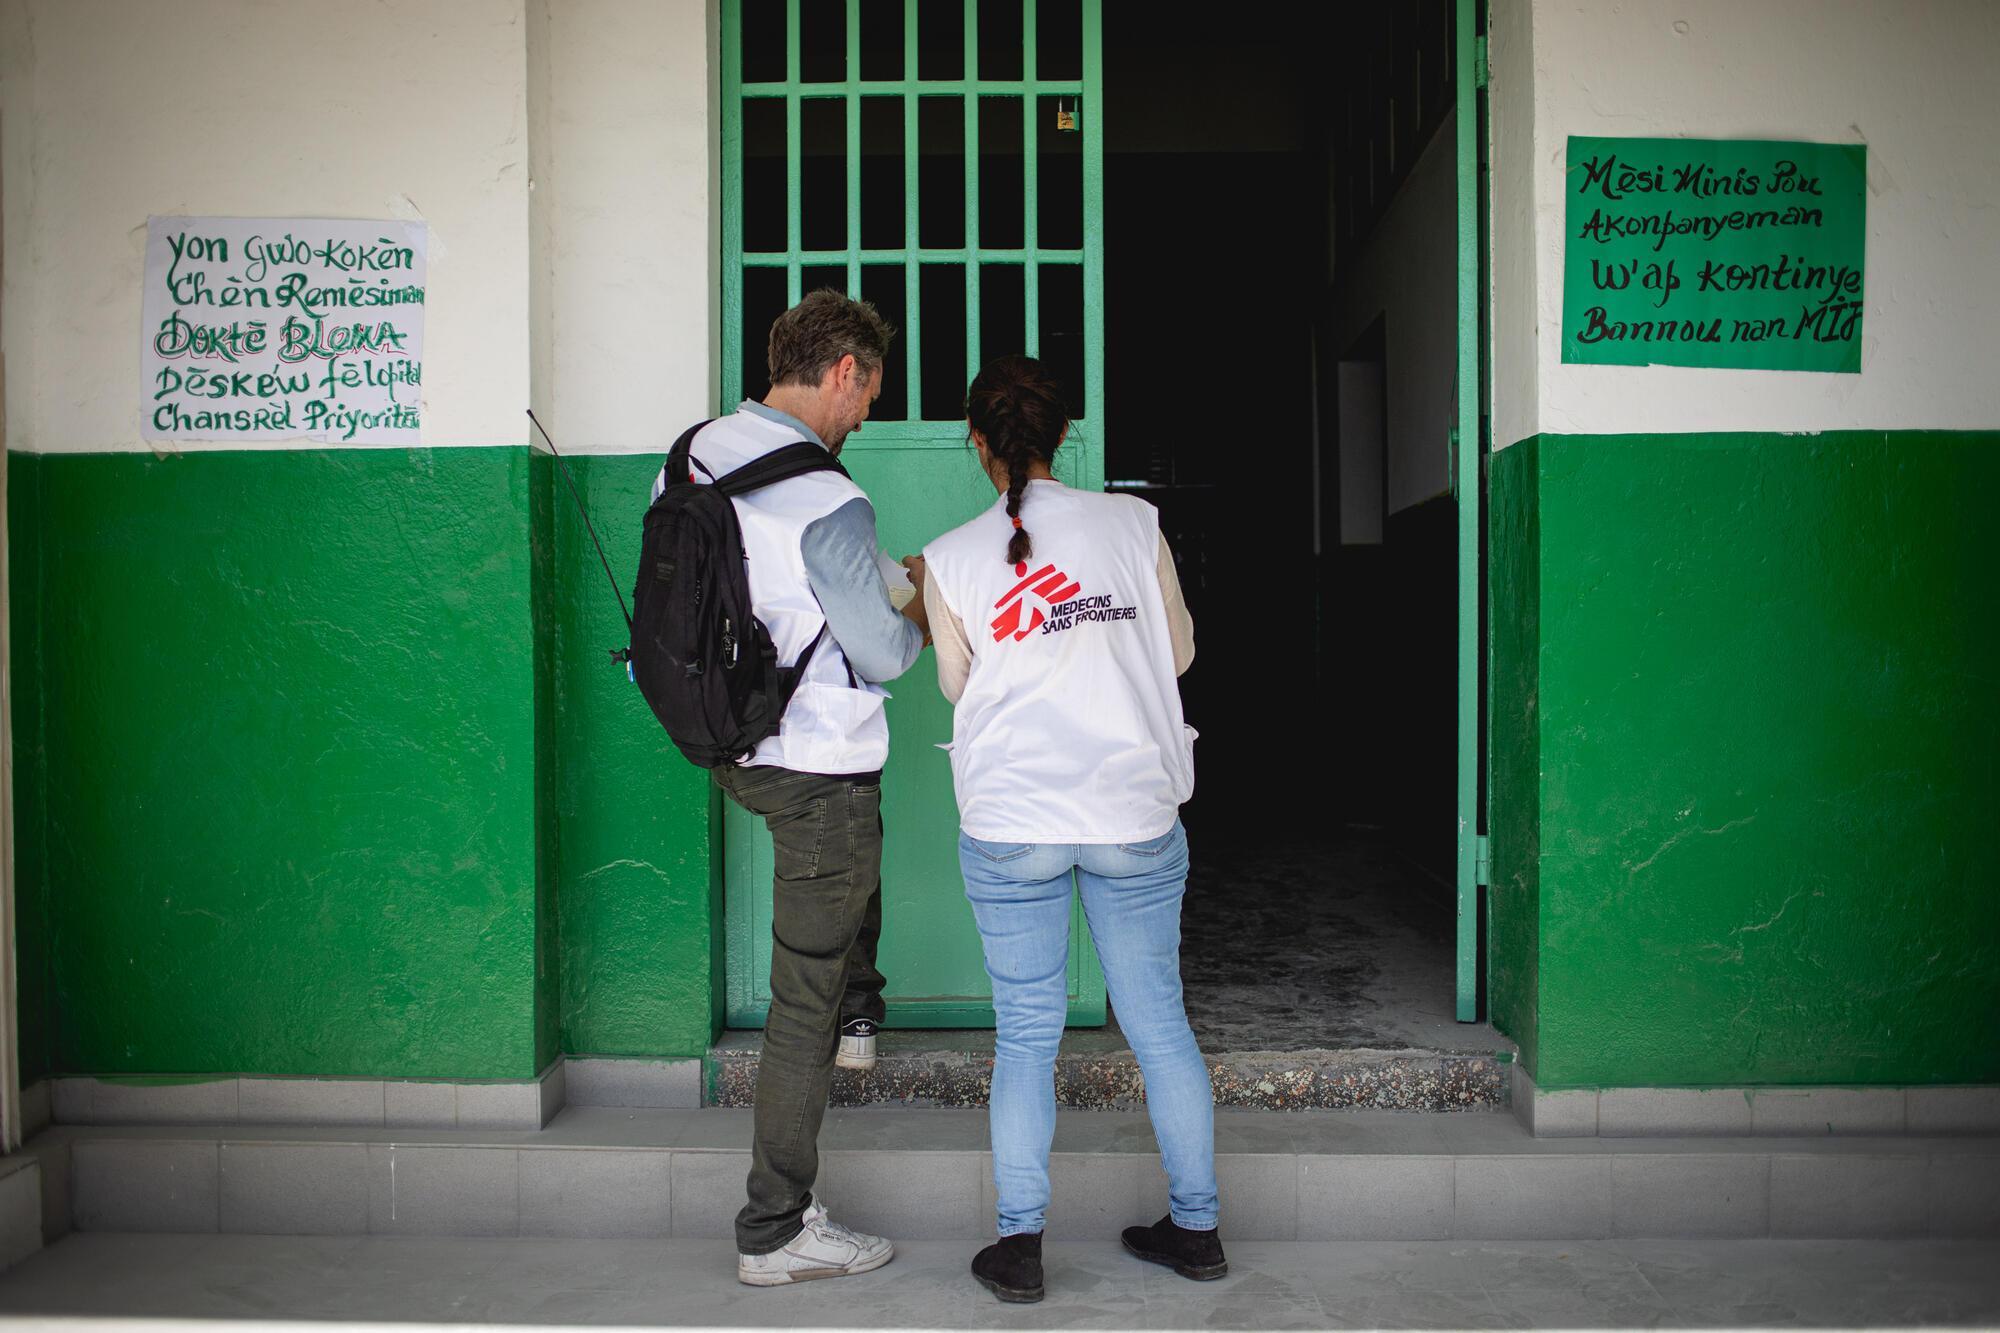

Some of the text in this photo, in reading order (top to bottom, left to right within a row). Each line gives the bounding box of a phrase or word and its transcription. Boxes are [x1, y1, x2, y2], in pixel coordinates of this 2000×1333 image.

[1673, 163, 1760, 199] Minis
[1766, 160, 1823, 196] Pou
[1730, 317, 1788, 342] nan
[1050, 594, 1112, 619] MEDECINS
[1042, 606, 1137, 635] SANS FRONTIERES
